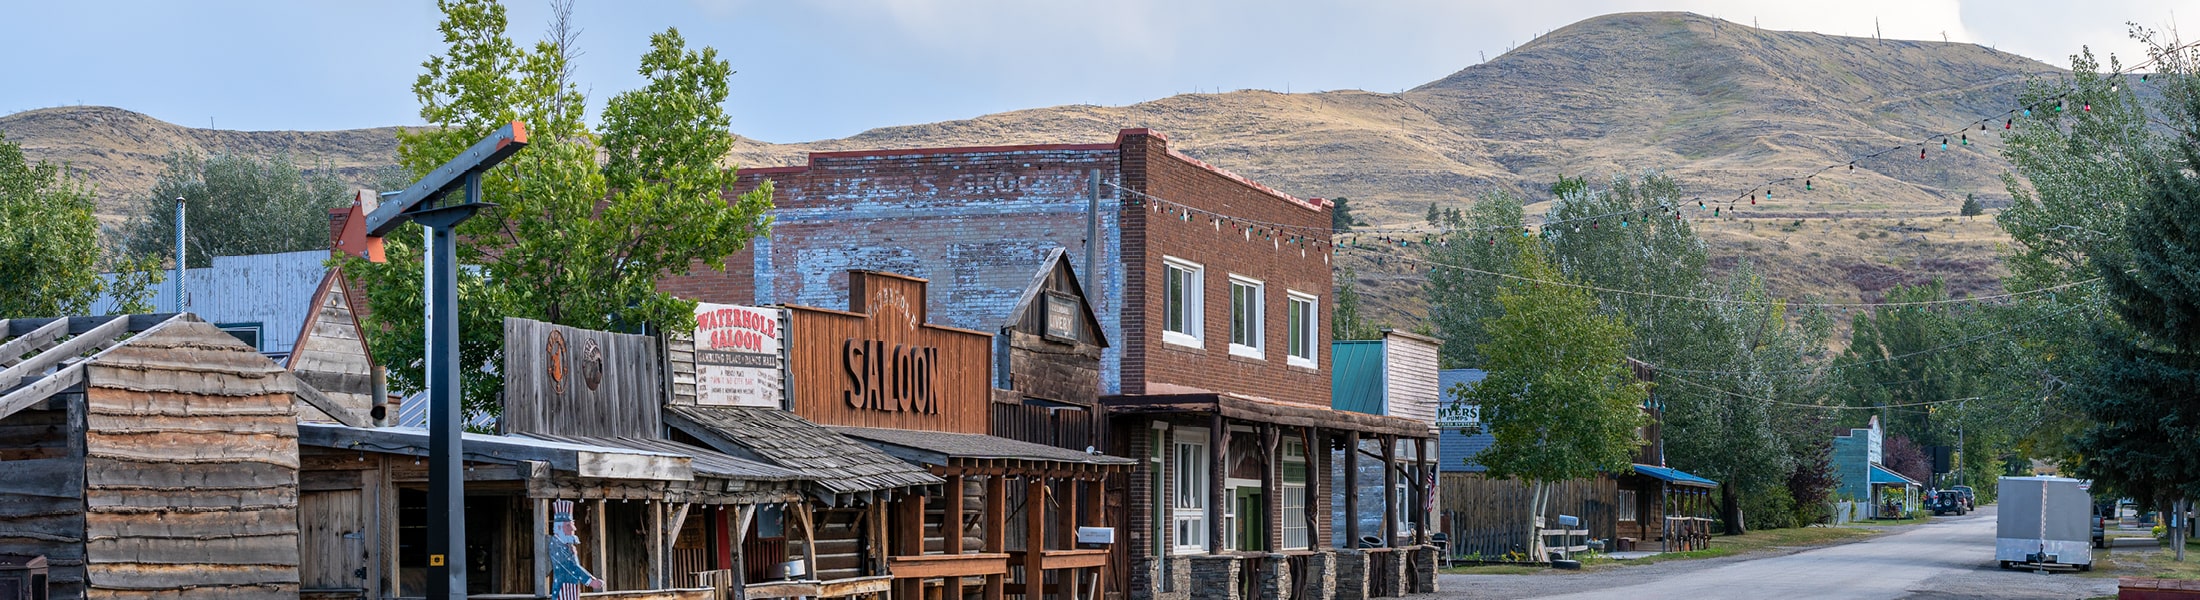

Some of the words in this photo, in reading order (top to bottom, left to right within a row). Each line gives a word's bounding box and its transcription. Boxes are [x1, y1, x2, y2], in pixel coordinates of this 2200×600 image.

[867, 288, 916, 330] WATERHOLE
[697, 309, 776, 339] WATERHOLE
[711, 330, 762, 352] SALOON
[763, 356, 775, 366] HALL
[843, 338, 942, 415] SALOON
[1438, 408, 1477, 419] MYERS
